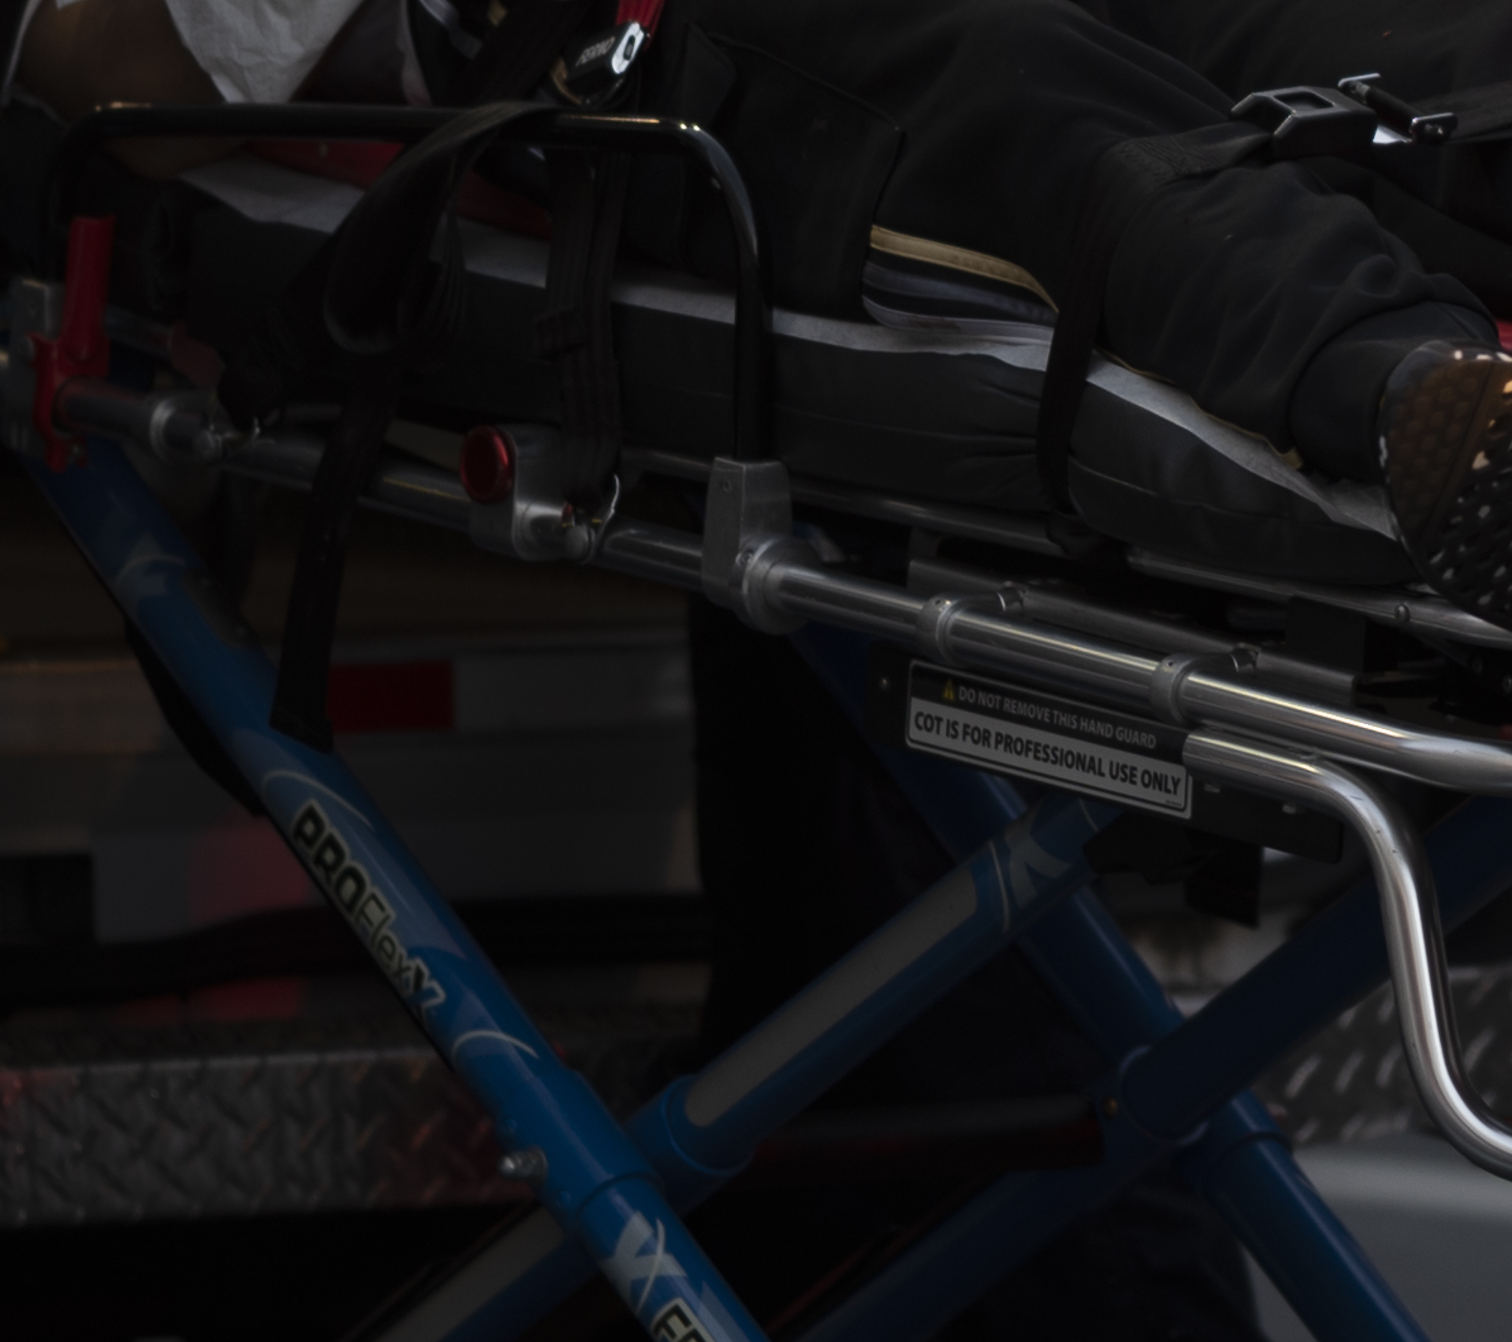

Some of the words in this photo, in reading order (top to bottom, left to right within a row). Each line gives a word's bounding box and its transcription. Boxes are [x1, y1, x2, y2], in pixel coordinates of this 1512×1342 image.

[575, 36, 615, 67] FERNO
[958, 685, 977, 703] DO
[978, 689, 1001, 710] NOT
[1003, 696, 1051, 723] REMOVE
[1053, 709, 1078, 730] THIS
[1080, 714, 1113, 739] HAND
[1115, 724, 1156, 749] GUARD
[914, 710, 943, 736] COT
[946, 717, 959, 739] IS
[962, 721, 993, 748] FOR
[994, 729, 1106, 778] PROFESSIONAL
[1109, 760, 1138, 786] USE
[1141, 769, 1181, 797] ONLY
